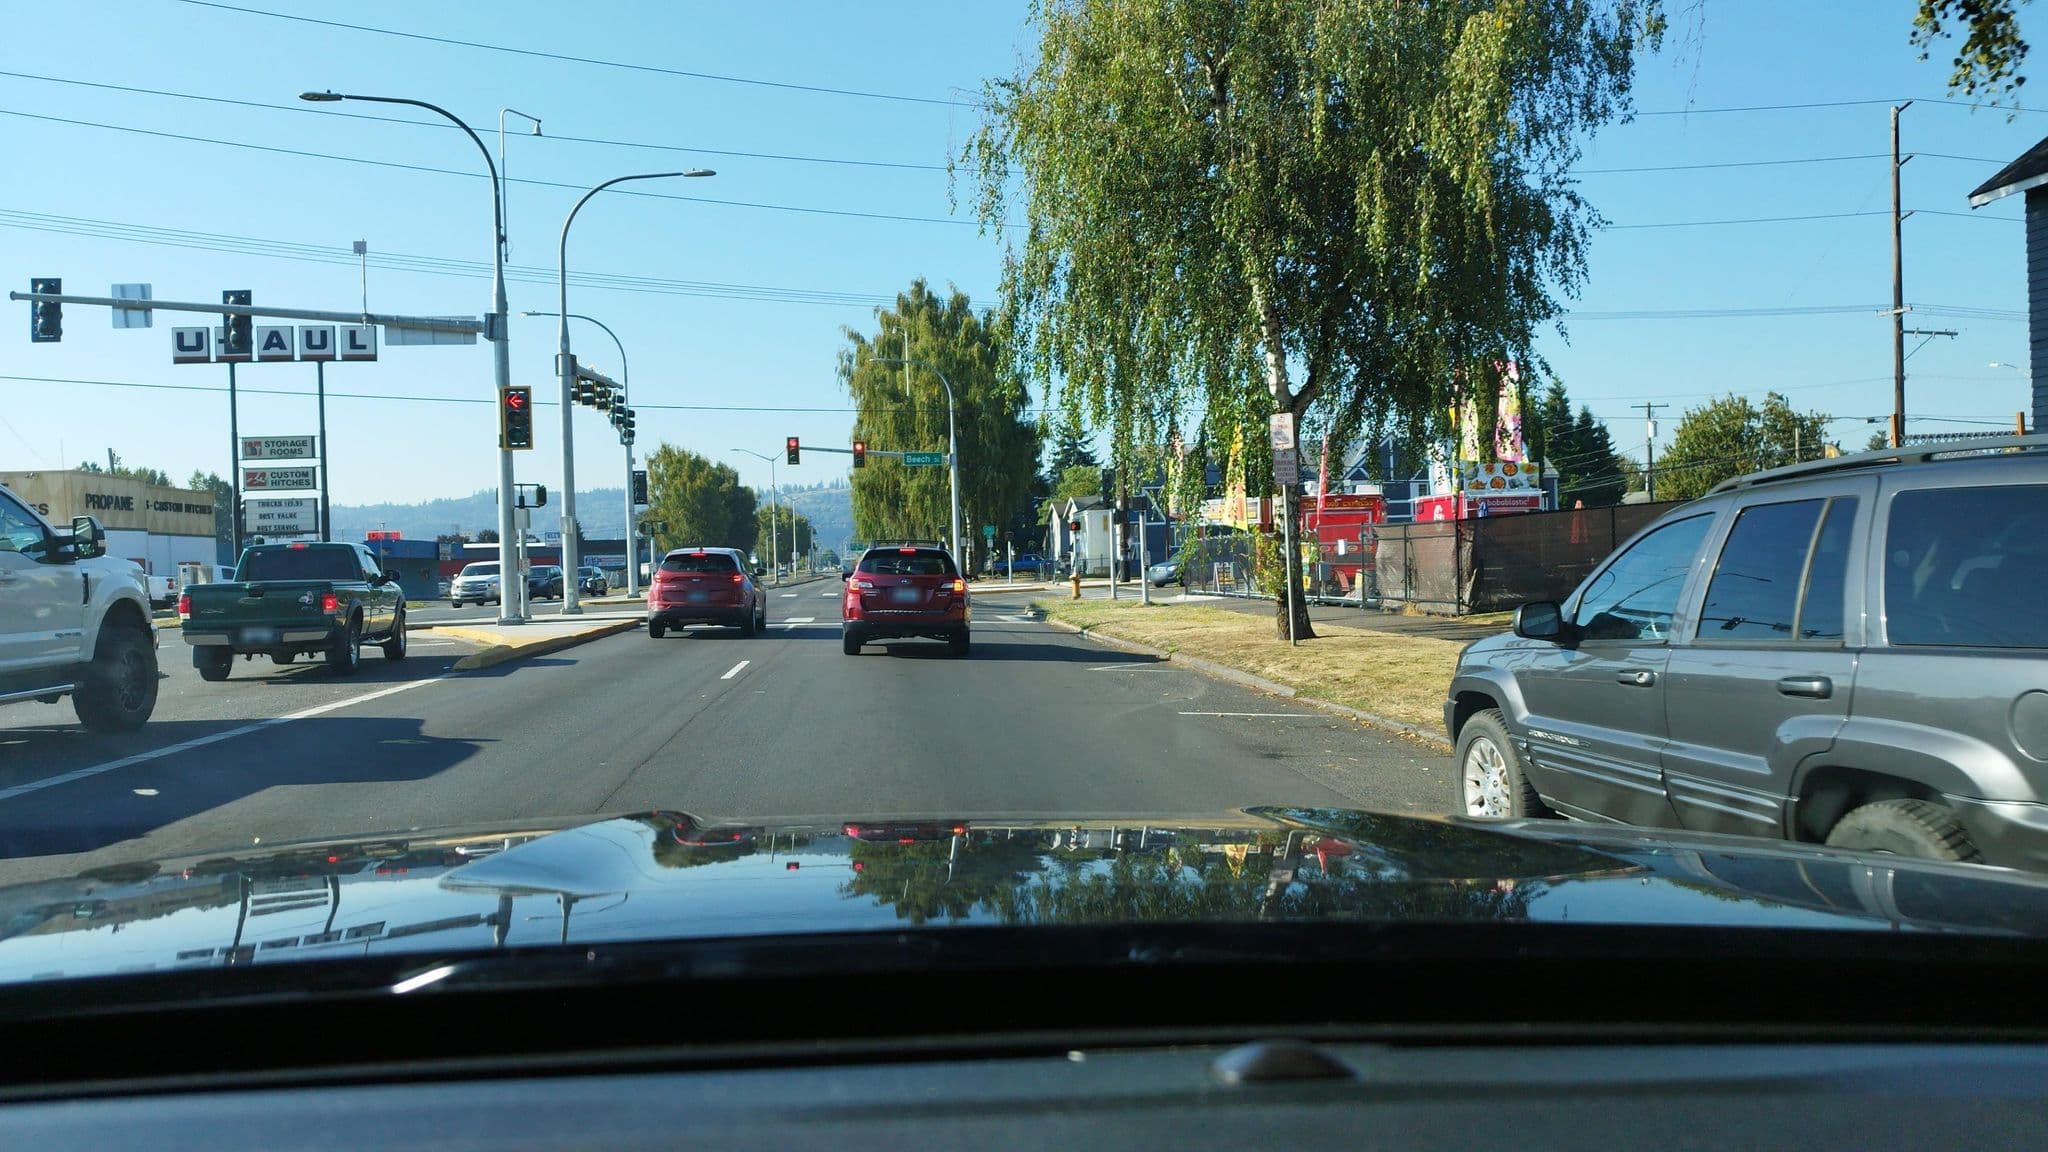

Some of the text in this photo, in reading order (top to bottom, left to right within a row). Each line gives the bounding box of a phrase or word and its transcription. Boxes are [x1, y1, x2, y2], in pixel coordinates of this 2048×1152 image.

[176, 329, 368, 352] U-AUL
[264, 440, 308, 448] STORAGE
[906, 455, 931, 463] Beech
[271, 479, 311, 487] HITCHES
[85, 493, 134, 511] PROPANE
[153, 501, 183, 512] CUSTOM
